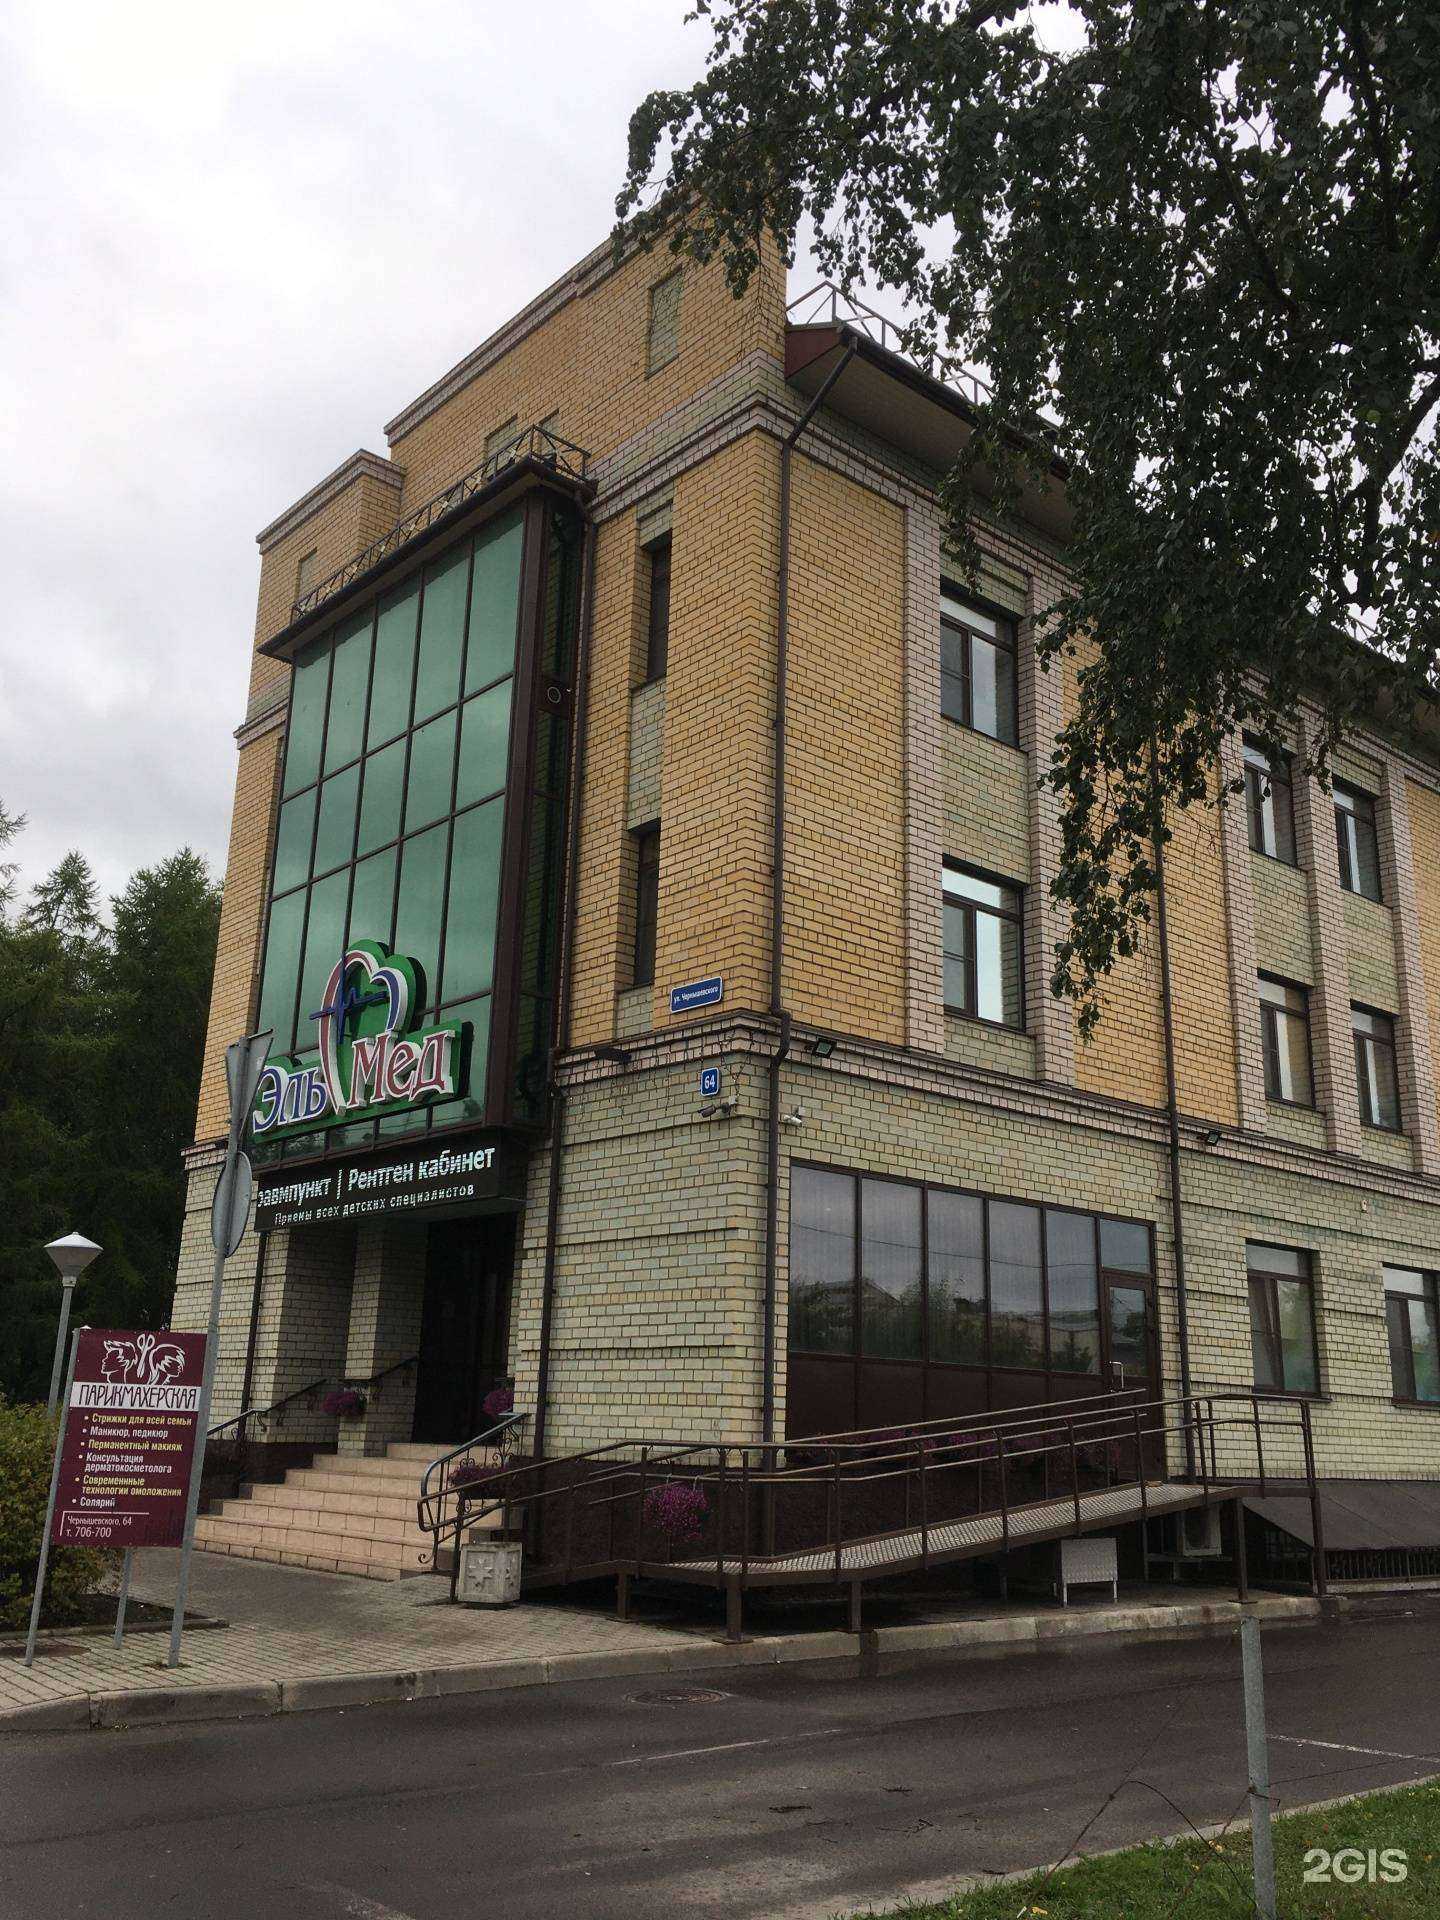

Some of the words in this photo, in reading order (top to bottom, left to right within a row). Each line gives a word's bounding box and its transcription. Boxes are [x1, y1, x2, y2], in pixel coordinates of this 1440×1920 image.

[253, 1065, 327, 1133] Эль
[345, 1029, 455, 1110] Мед
[704, 1075, 716, 1089] 64
[347, 1163, 414, 1191] Рентген
[418, 1147, 495, 1181] кабинет
[316, 1205, 340, 1220] всех
[342, 1198, 386, 1218] детских
[389, 1184, 475, 1207] специалистов
[79, 1384, 197, 1409] ПАРИКМАХЕРСКАЯ
[92, 1413, 128, 1425] Стрижки
[129, 1416, 144, 1425] для
[146, 1415, 165, 1425] всей
[167, 1417, 192, 1426] семьи
[90, 1426, 131, 1438] Маникюр,
[132, 1429, 169, 1439] педикюр
[88, 1439, 150, 1451] Перманентный
[151, 1442, 183, 1452] макияж
[86, 1452, 144, 1464] Консультация
[84, 1462, 172, 1474] дерматокосметолога
[82, 1486, 129, 1495] технологии
[130, 1487, 182, 1497] омоложения
[80, 1496, 115, 1508] Солярий
[122, 1516, 132, 1526] 64
[66, 1529, 72, 1537] т.
[75, 1526, 112, 1538] 706-700
